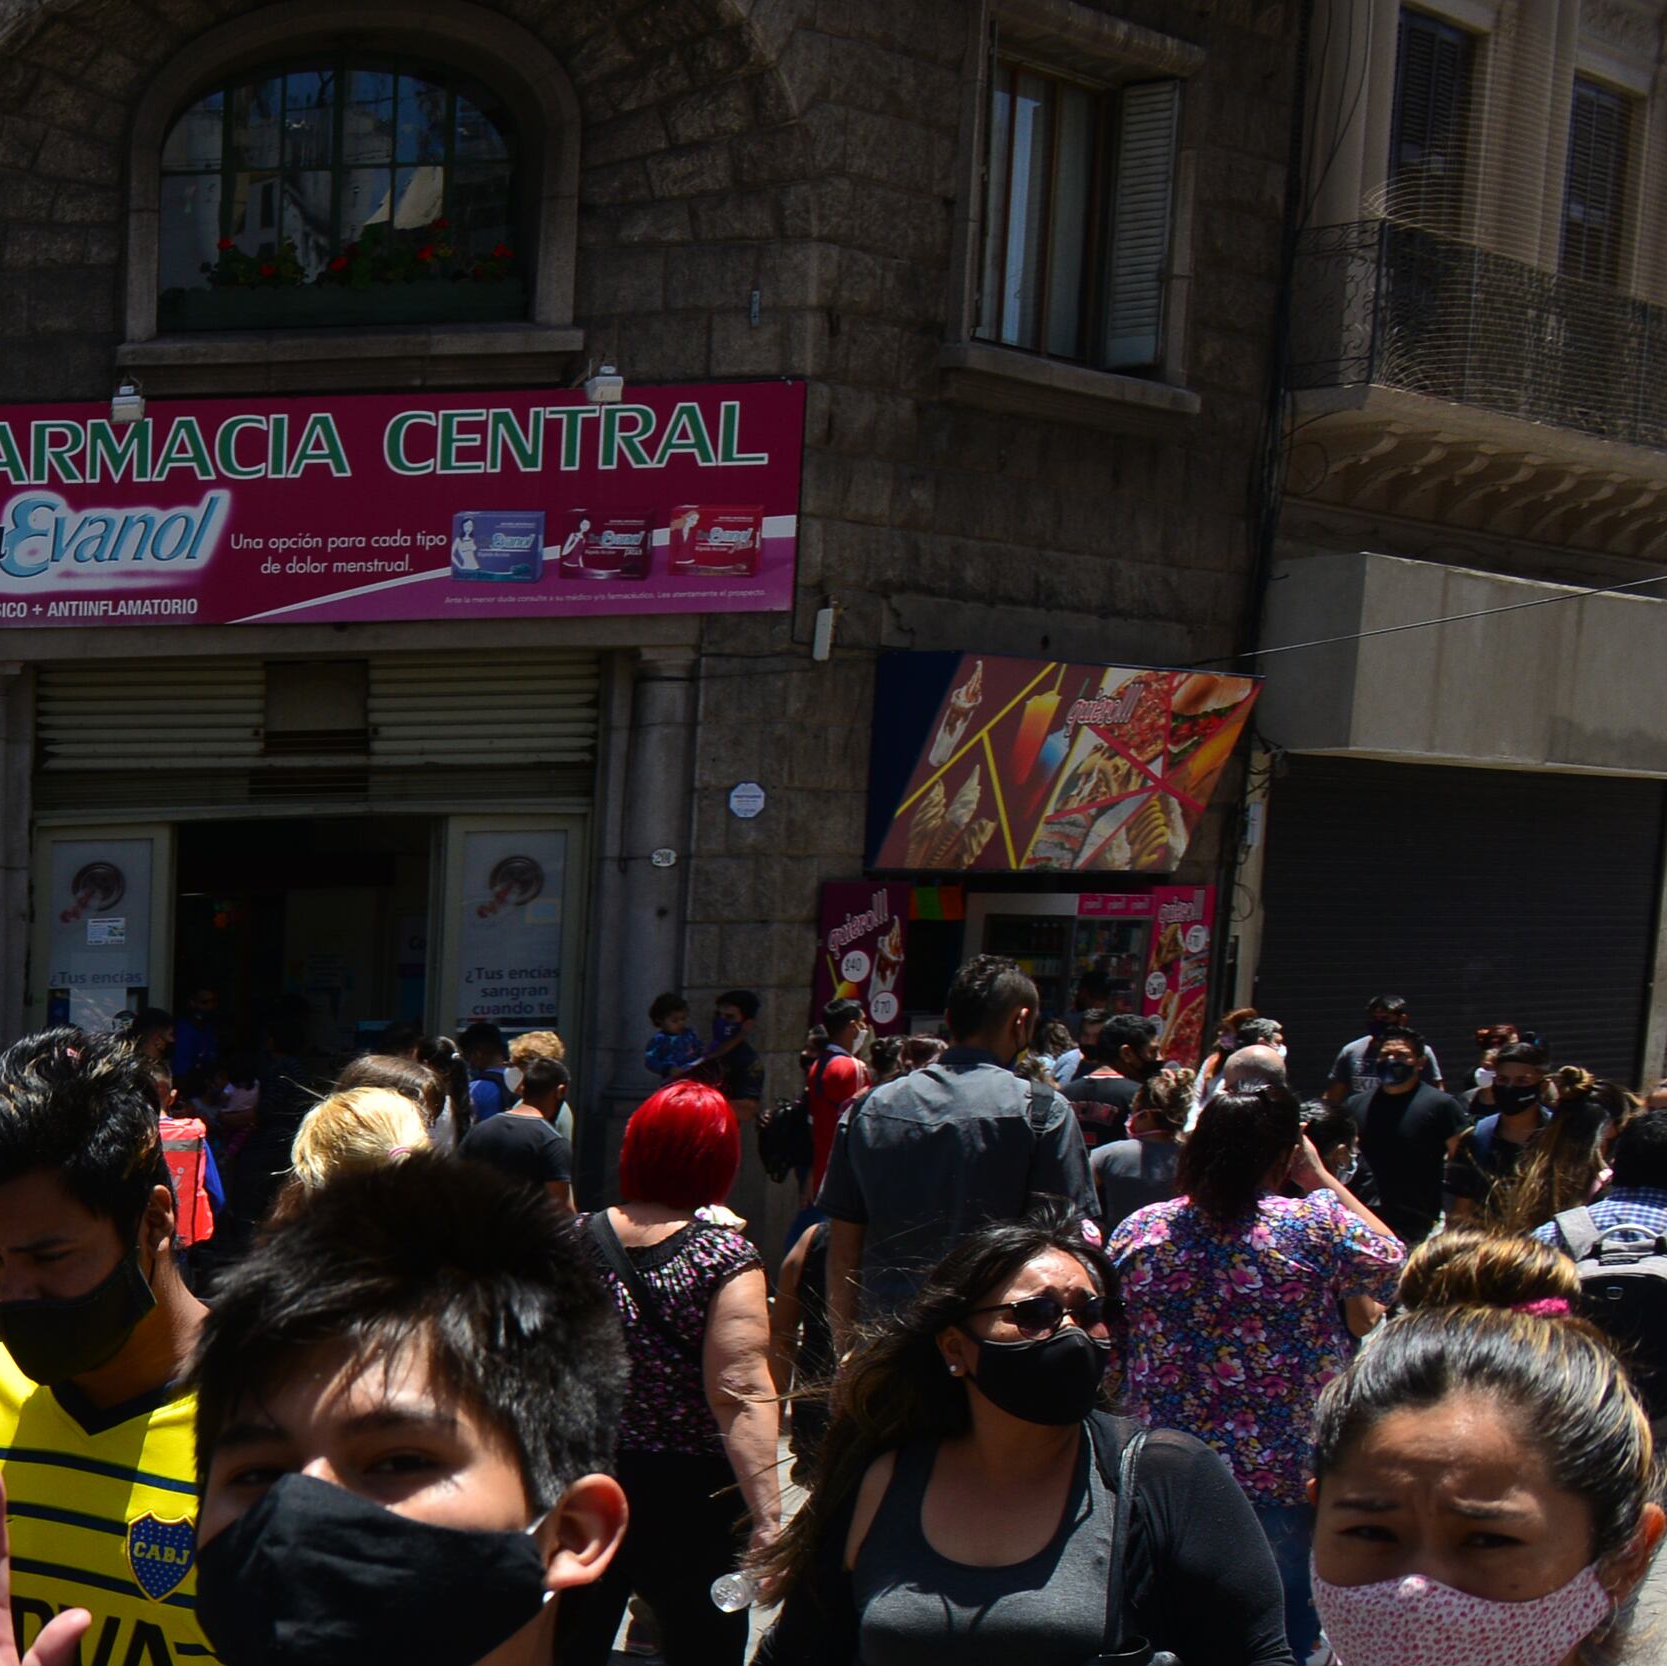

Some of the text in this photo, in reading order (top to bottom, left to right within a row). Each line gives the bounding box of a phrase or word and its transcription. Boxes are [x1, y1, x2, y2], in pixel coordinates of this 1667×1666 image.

[383, 401, 768, 475] CENTRAL
[230, 528, 447, 553] Una opción para cada tipo
[260, 554, 414, 574] de dolor menstrual.
[31, 603, 44, 617] +
[47, 598, 198, 618] ANTIINFLAMATORIO
[50, 969, 142, 987] ¿Tus encías
[465, 967, 504, 983] ¿Tus
[481, 985, 548, 1000] sangran
[472, 1001, 555, 1016] cuando te
[133, 1541, 191, 1566] CABJ
